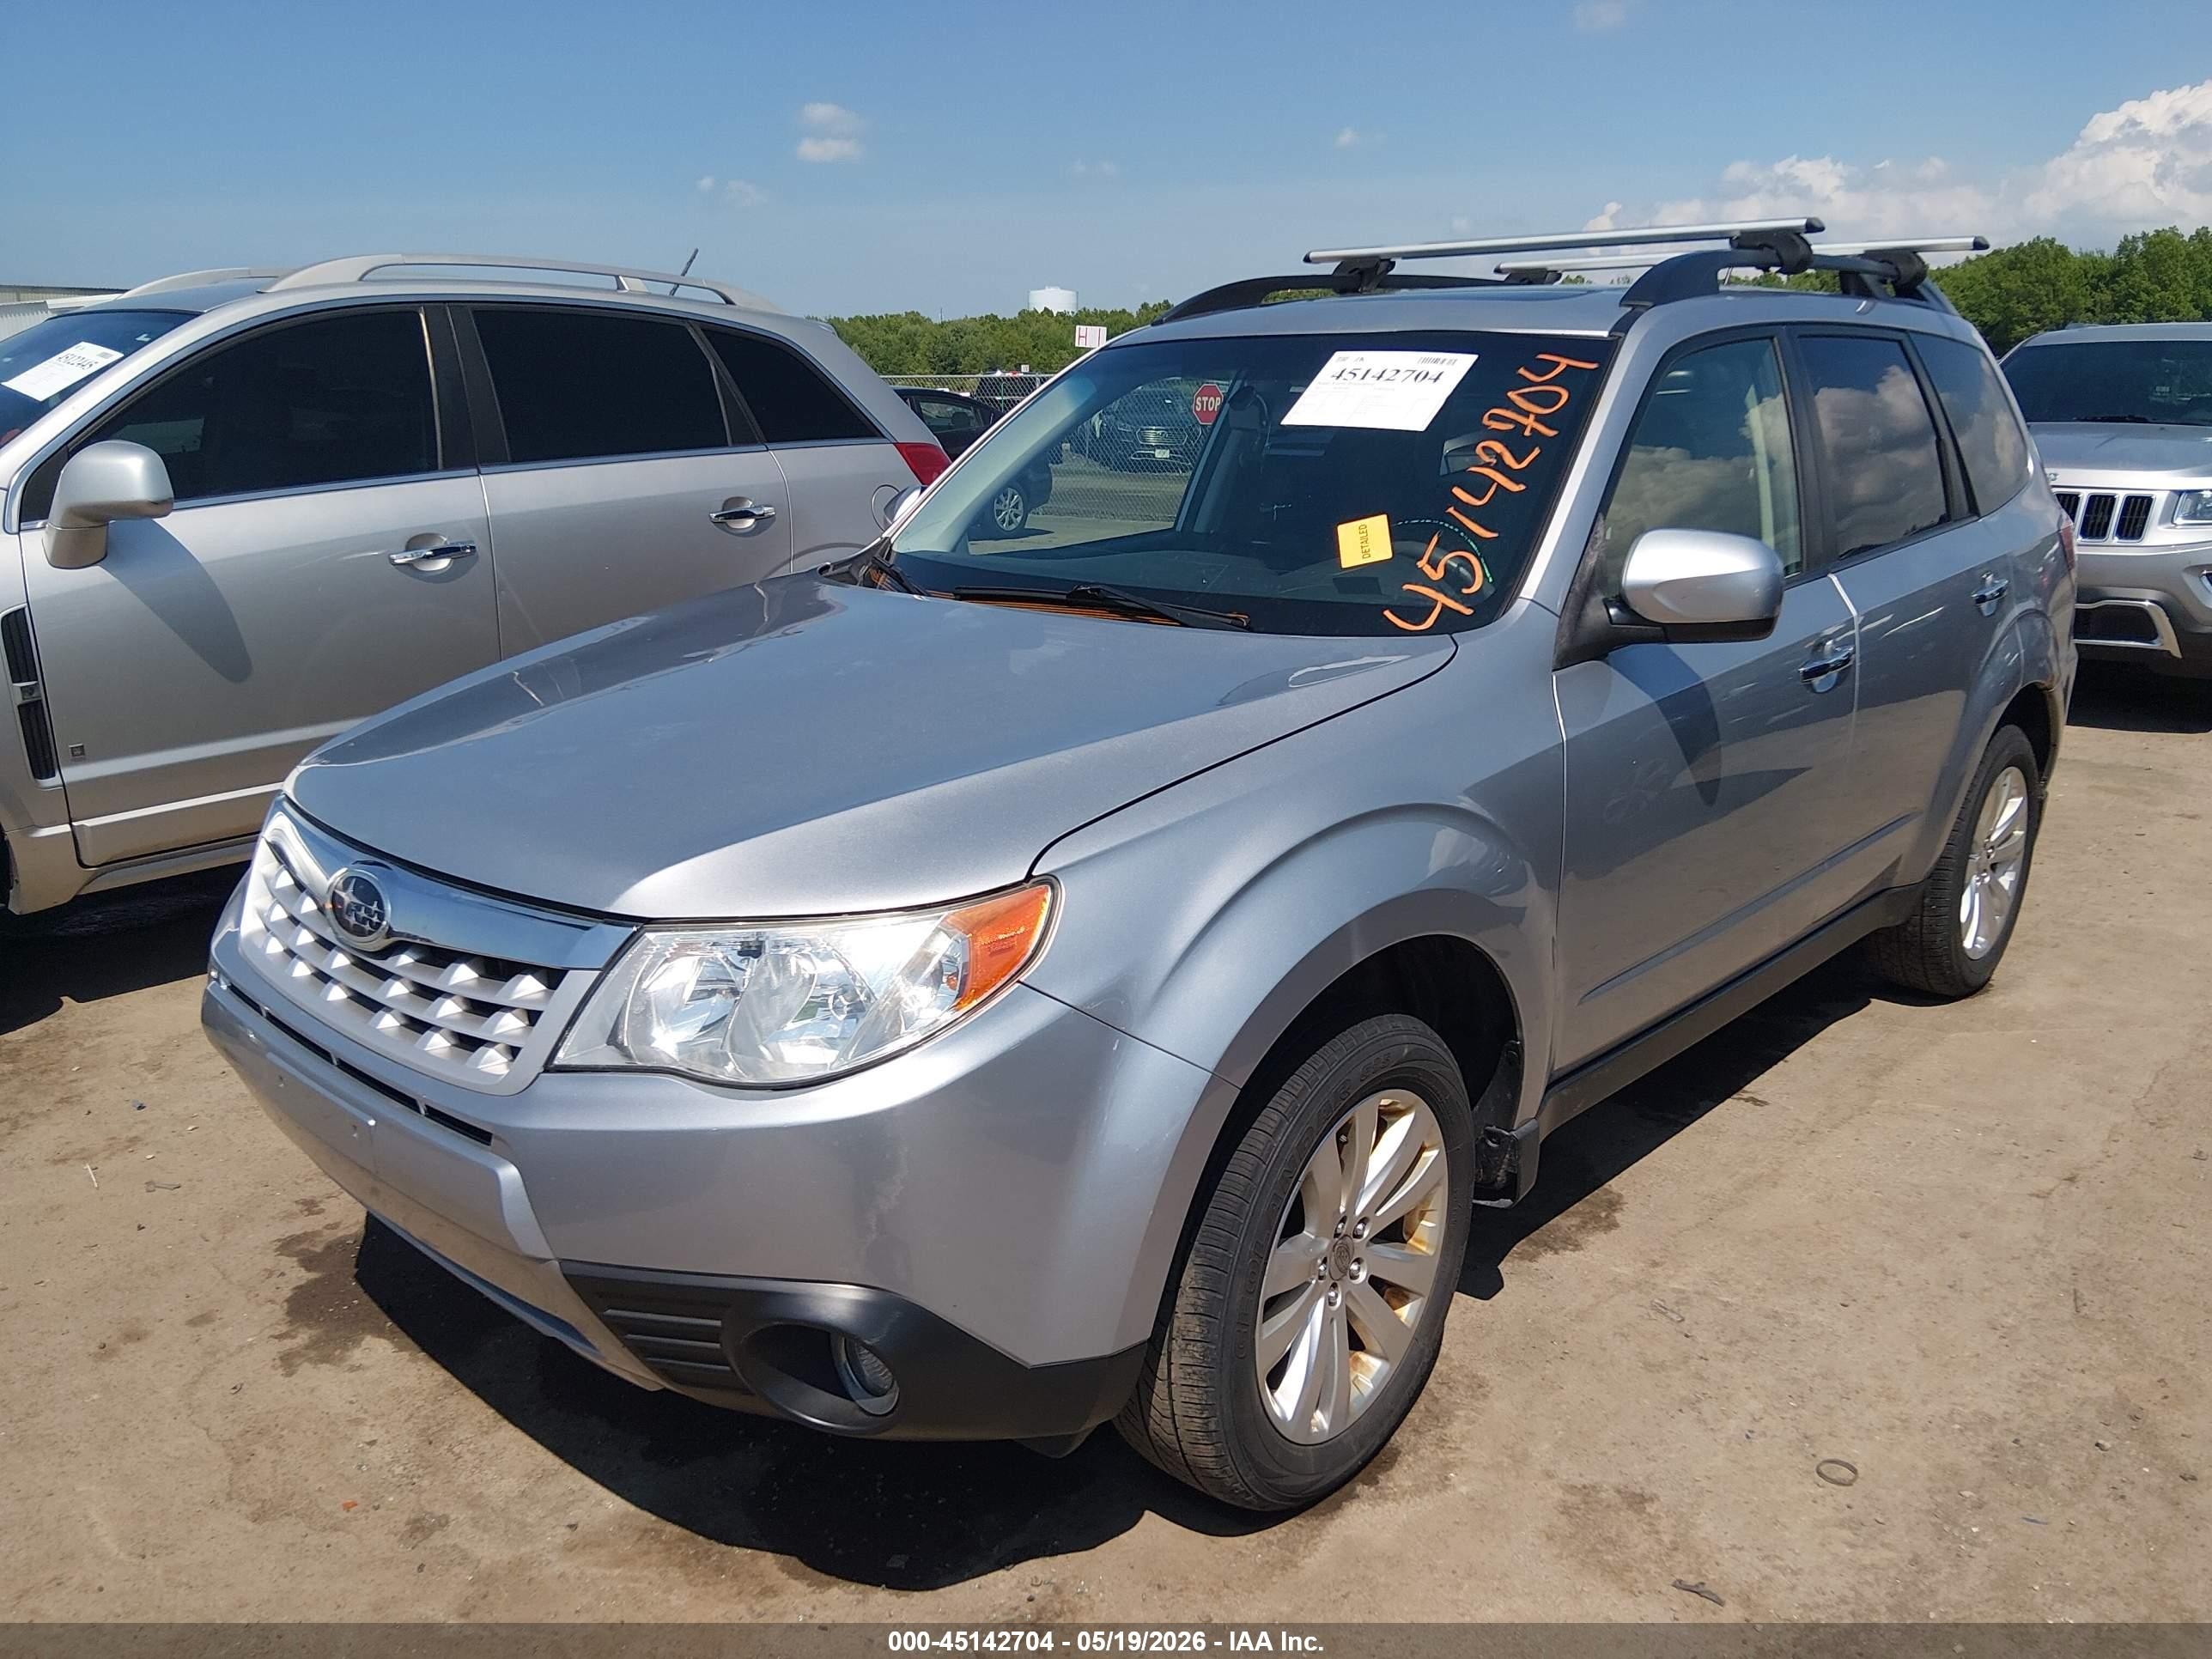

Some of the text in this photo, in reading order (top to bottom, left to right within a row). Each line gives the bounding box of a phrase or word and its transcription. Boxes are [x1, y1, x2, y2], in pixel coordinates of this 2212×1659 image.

[1331, 368, 1444, 383] 45142704
[1195, 396, 1221, 412] STOP
[1382, 354, 1599, 630] 45142704
[1358, 523, 1371, 559] DETAILED
